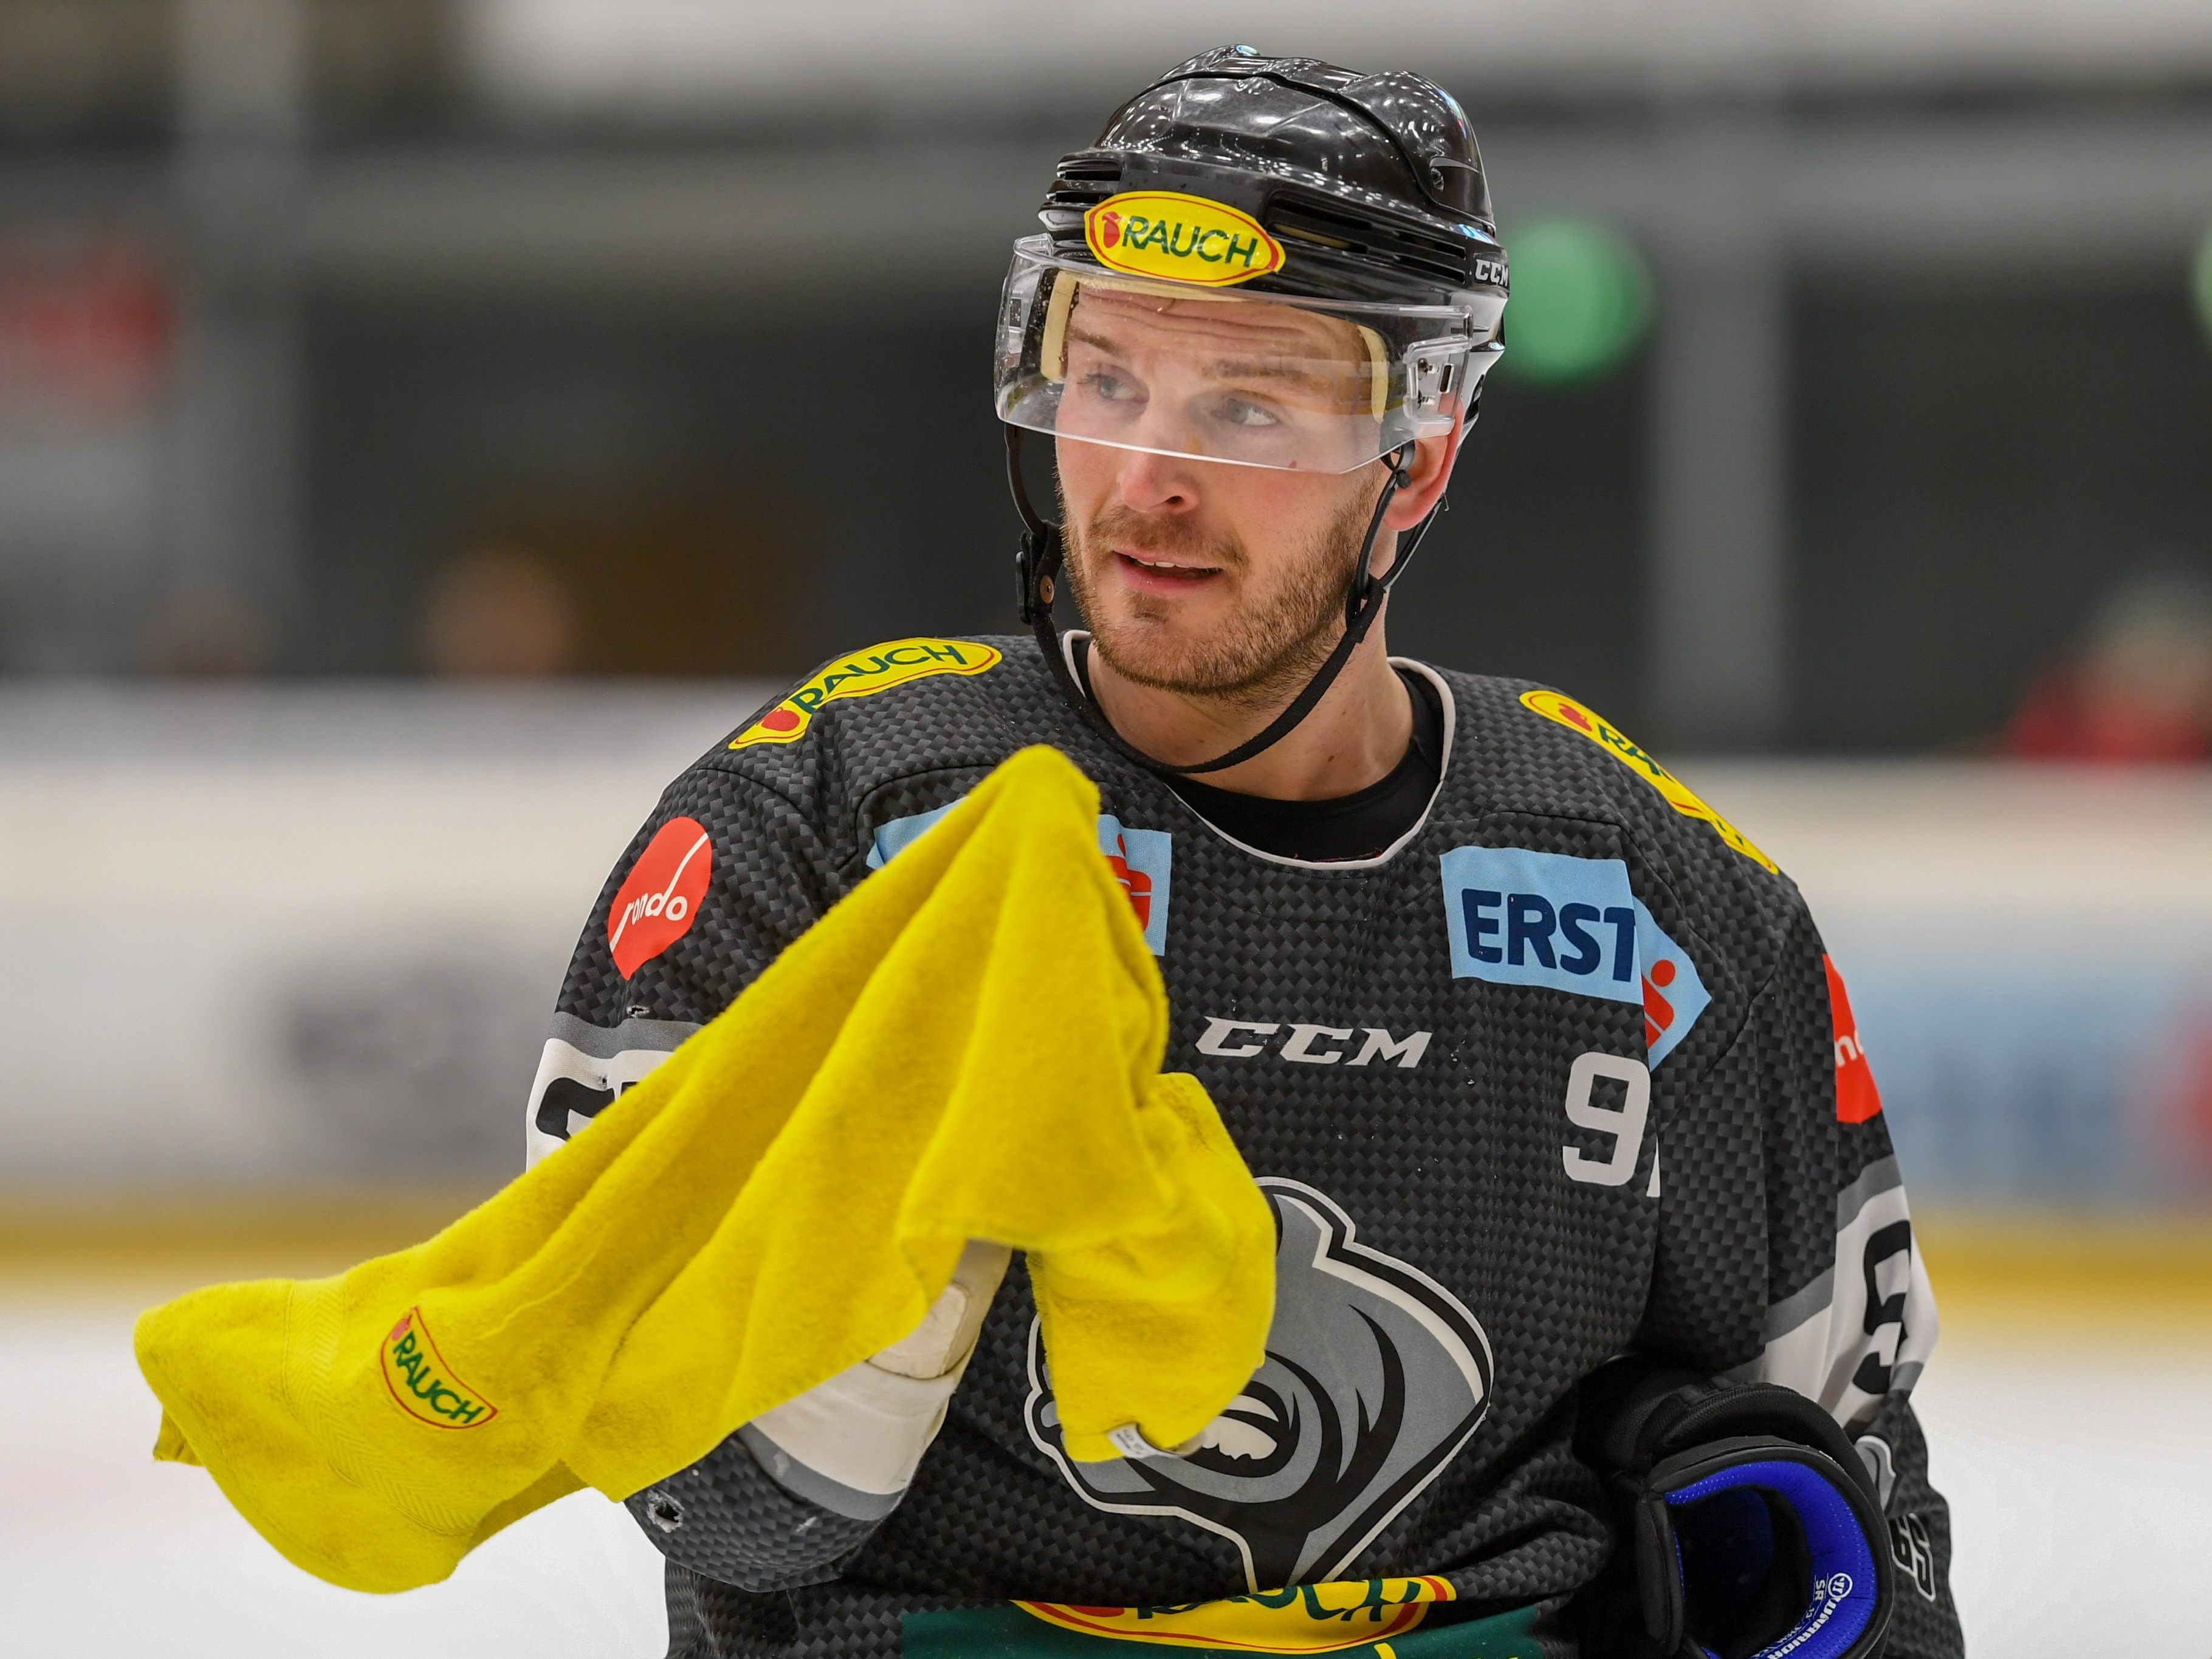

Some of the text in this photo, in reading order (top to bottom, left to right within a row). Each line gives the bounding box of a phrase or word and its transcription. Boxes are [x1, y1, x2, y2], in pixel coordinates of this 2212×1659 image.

[1122, 216, 1258, 267] RAUCH
[1475, 259, 1508, 287] CCM
[789, 645, 968, 715] RAUCH
[609, 832, 709, 953] rondo
[1195, 1015, 1433, 1068] CCM
[1562, 1051, 1661, 1198] 9
[393, 1330, 485, 1424] RAUCH
[1815, 1579, 1826, 1601] SR
